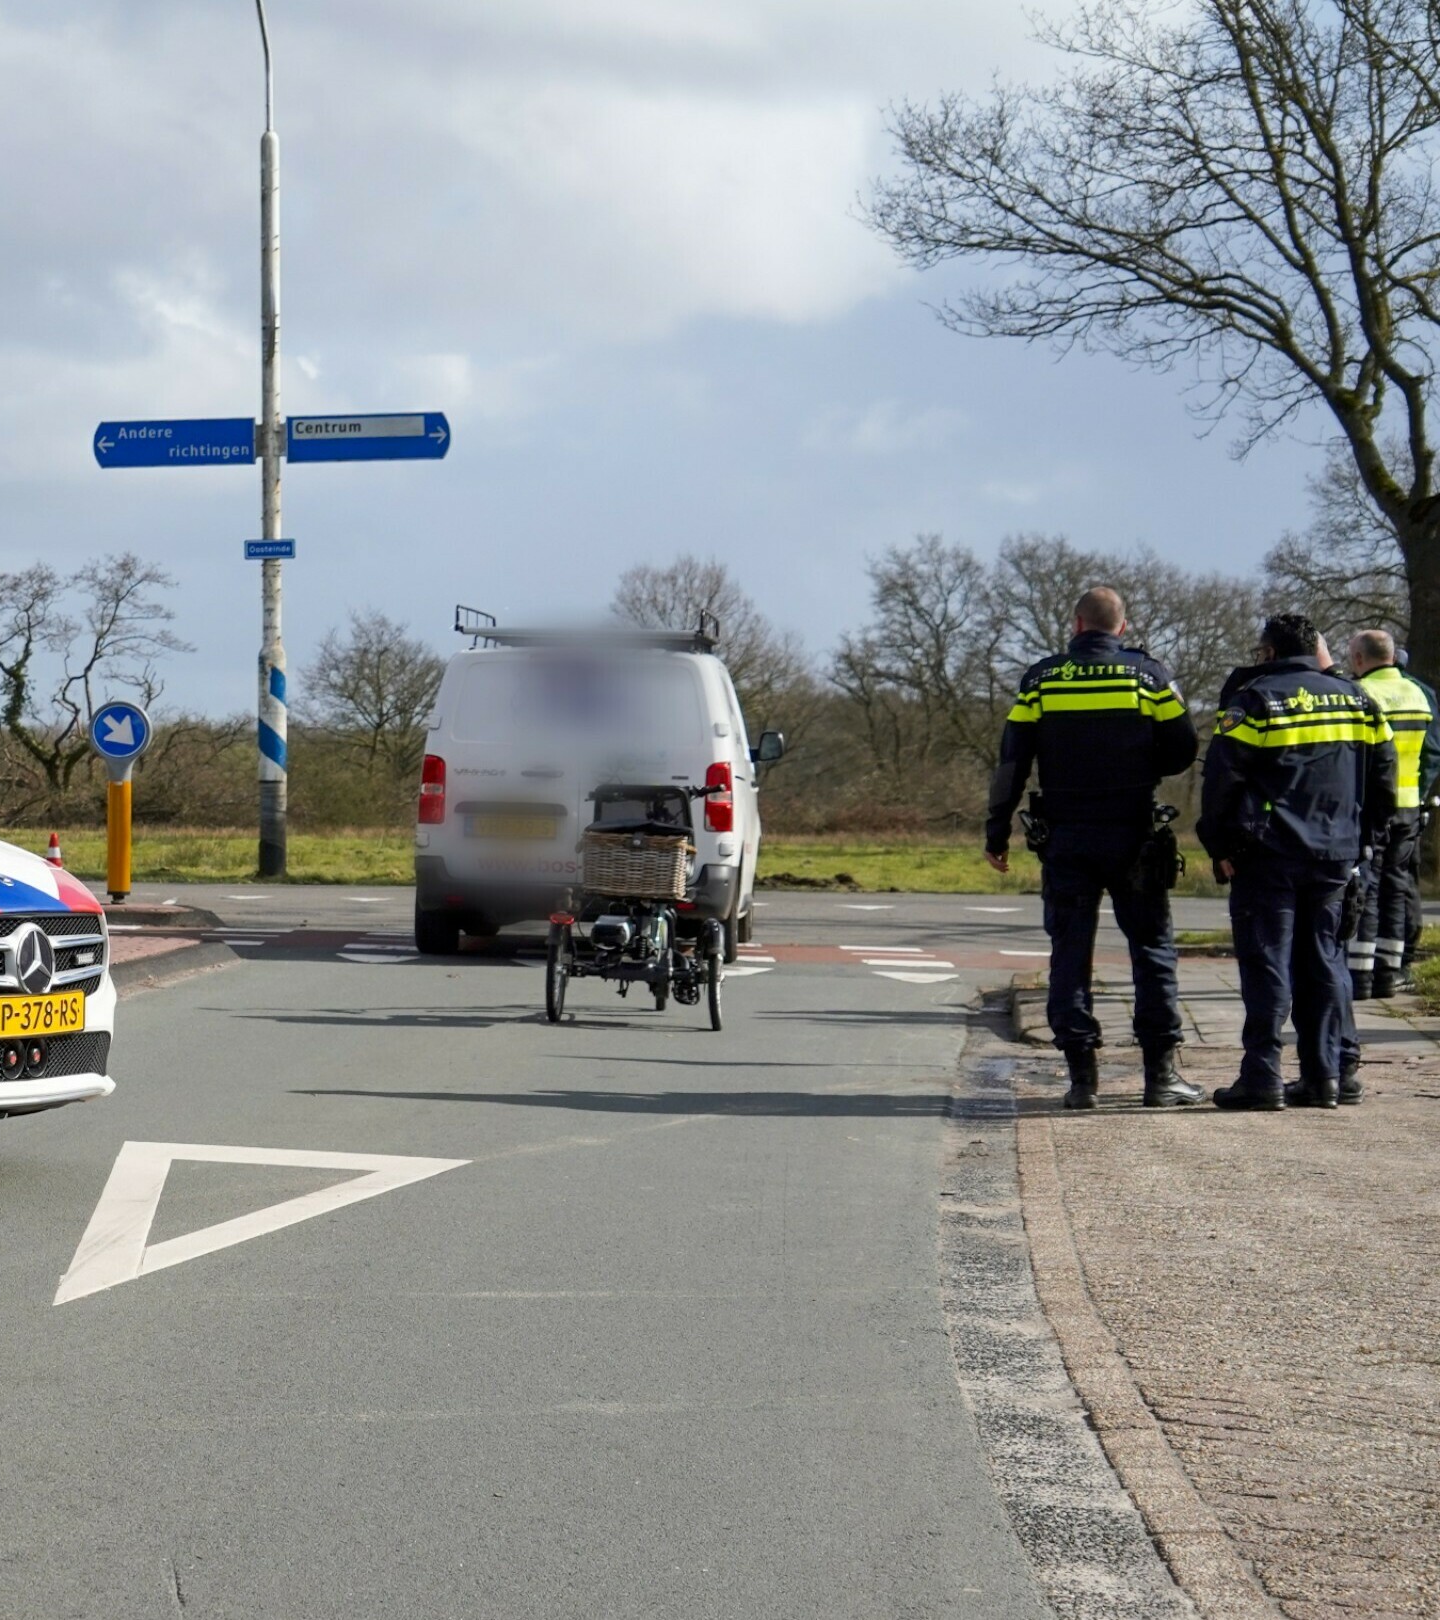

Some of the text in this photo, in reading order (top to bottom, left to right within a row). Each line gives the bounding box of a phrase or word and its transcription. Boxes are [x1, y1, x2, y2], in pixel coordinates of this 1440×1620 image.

[118, 427, 173, 440] Andere
[295, 422, 363, 434] Centrum
[169, 444, 250, 460] richtingen
[1051, 662, 1126, 681] POLITIE
[1288, 691, 1357, 712] POLITIE
[1, 998, 79, 1031] P-378-RS
